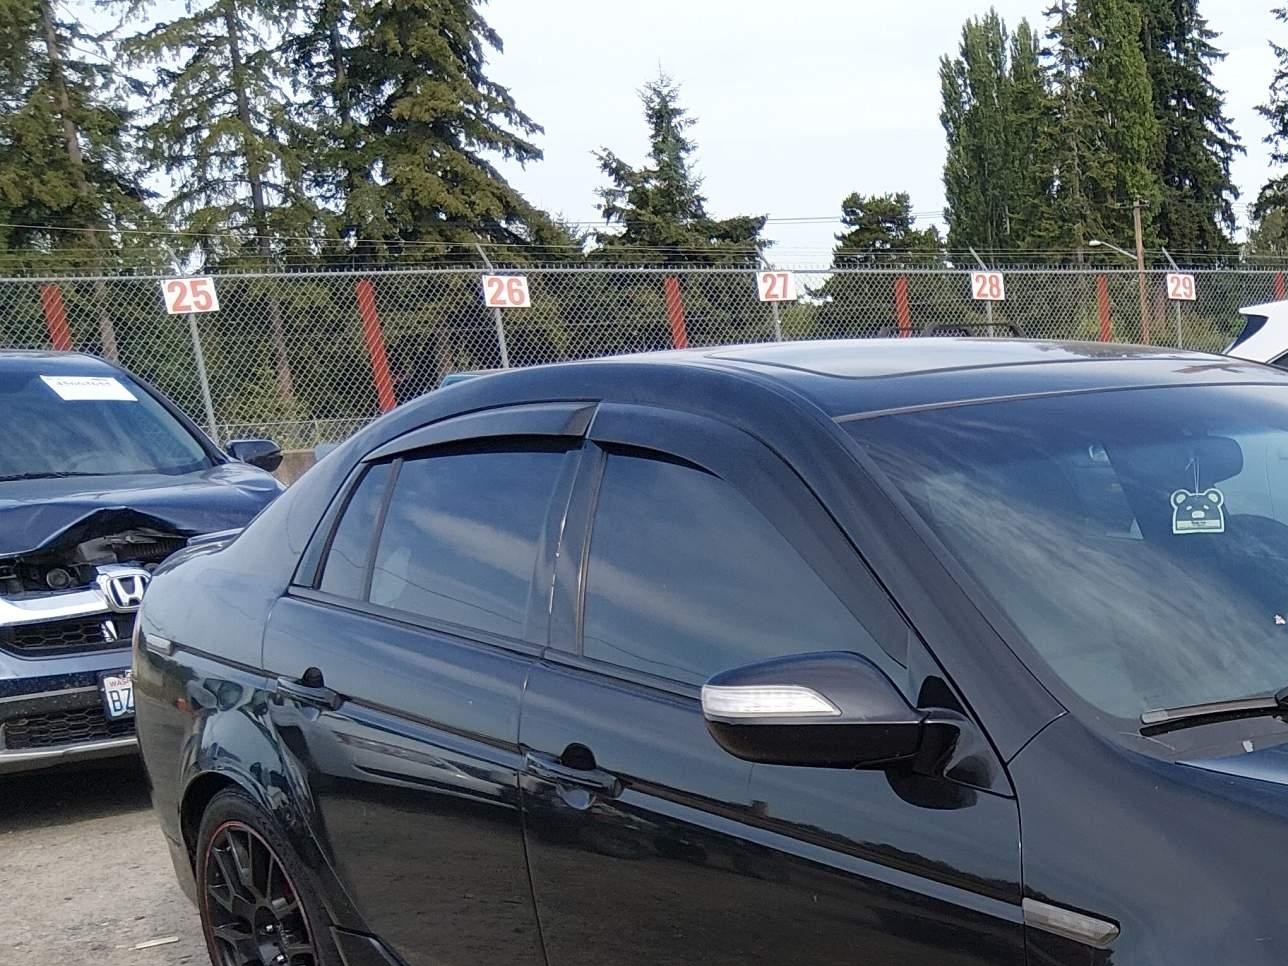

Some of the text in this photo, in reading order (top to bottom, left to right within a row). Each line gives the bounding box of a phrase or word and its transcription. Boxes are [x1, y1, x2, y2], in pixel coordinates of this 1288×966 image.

[167, 280, 212, 312] 25
[487, 277, 526, 305] 26
[762, 273, 788, 299] 27
[975, 274, 1001, 298] 28
[1170, 275, 1193, 298] 29
